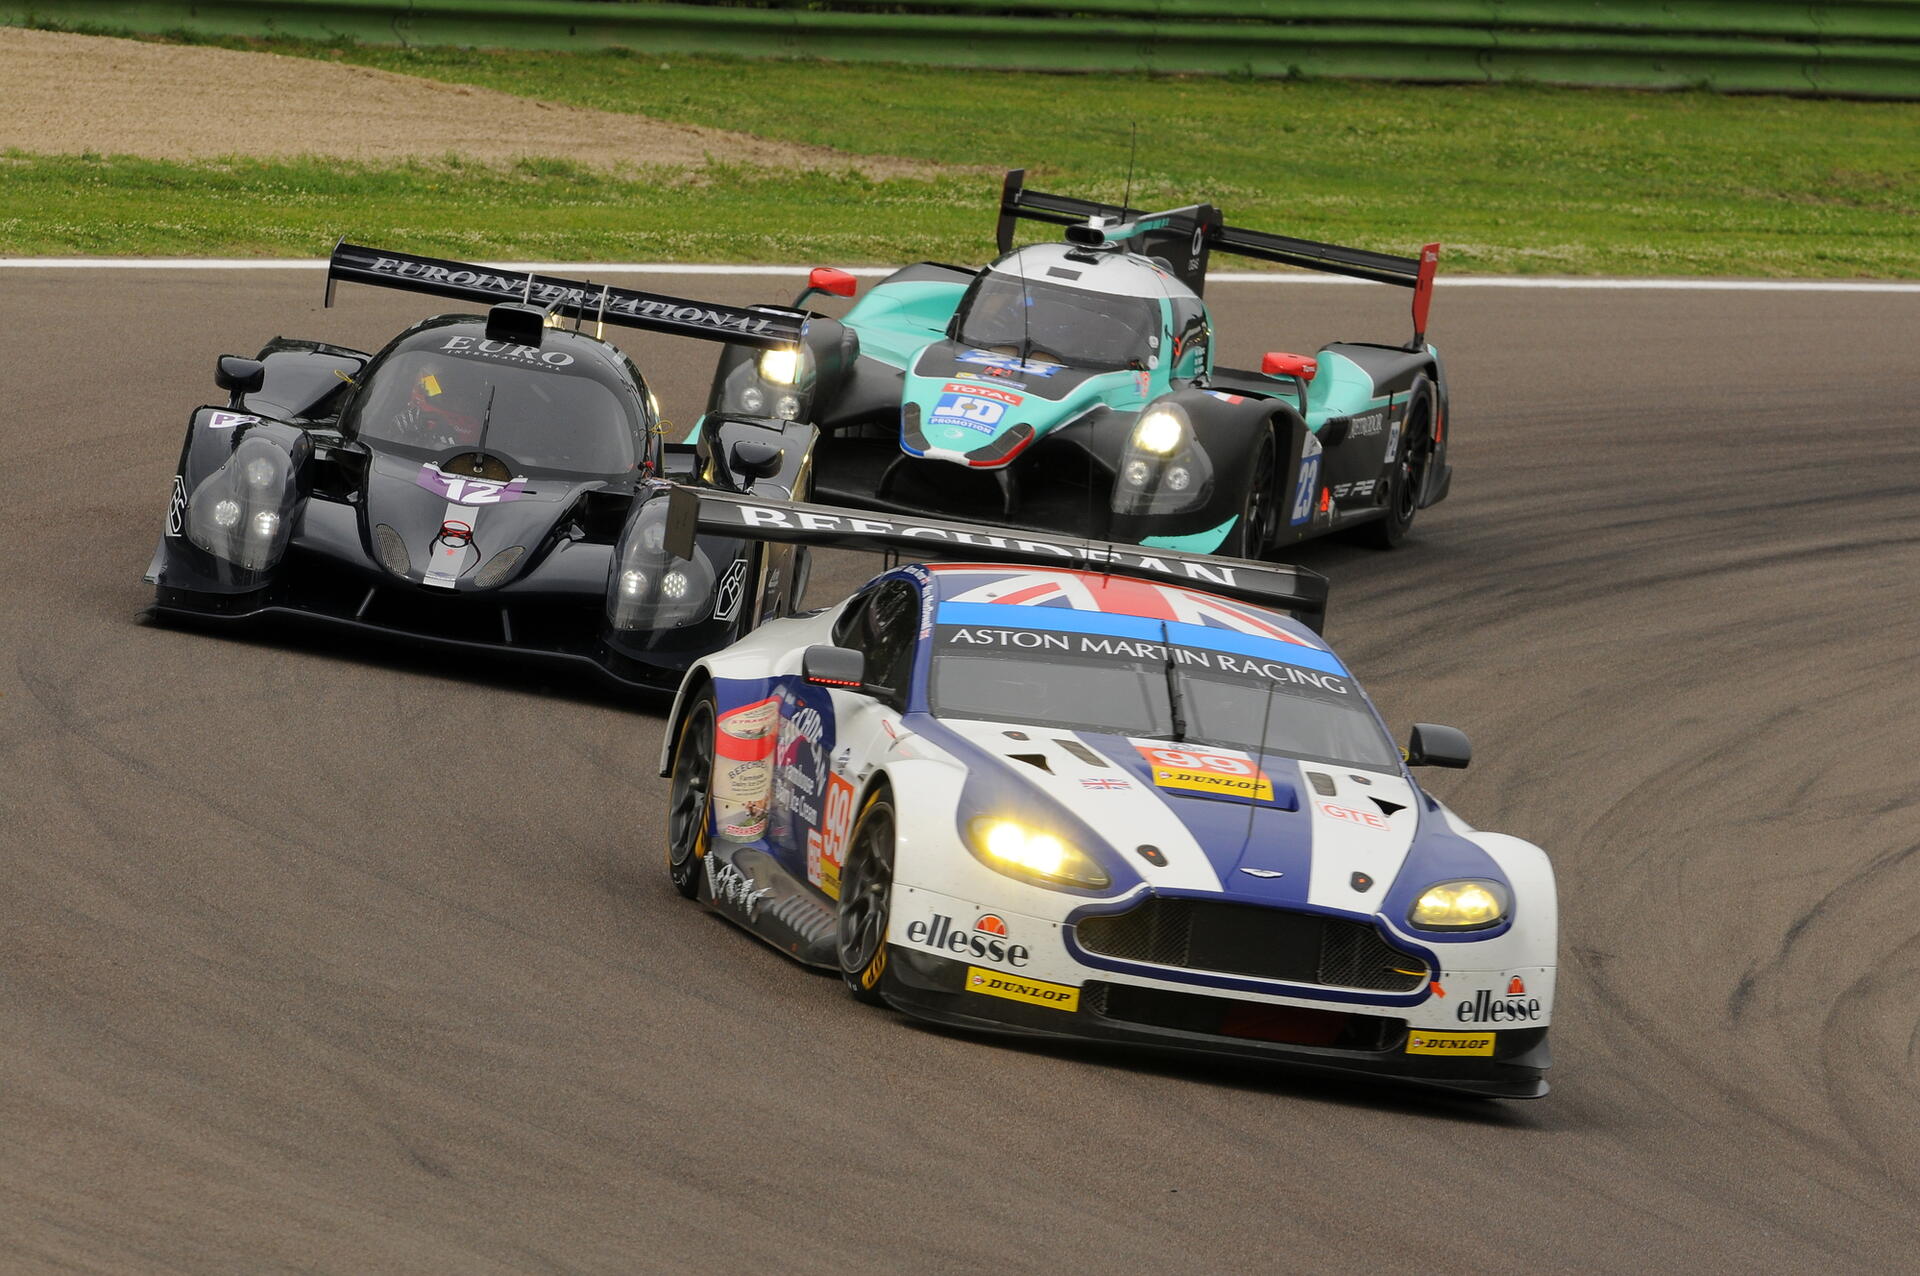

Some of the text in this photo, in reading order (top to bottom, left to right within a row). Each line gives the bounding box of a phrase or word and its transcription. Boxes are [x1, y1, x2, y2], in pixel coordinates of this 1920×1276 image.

[369, 255, 777, 335] EUROINTERNATIONAL
[440, 335, 575, 366] EURO
[950, 383, 1018, 404] TOTAL
[934, 395, 1005, 424] JD
[930, 417, 994, 435] PROMOTION
[438, 478, 506, 504] 12
[1291, 459, 1318, 520] 23
[950, 628, 1348, 695] ASTON MARTIN RACING
[1151, 749, 1252, 775] 99
[1176, 773, 1267, 791] DUNLOP
[824, 782, 851, 865] 99
[1323, 803, 1384, 828] GTE
[908, 913, 1029, 967] ellesse
[988, 978, 1071, 1002] DUNLOP
[1457, 989, 1540, 1022] ellesse
[1426, 1039, 1490, 1049] DUNLOP
